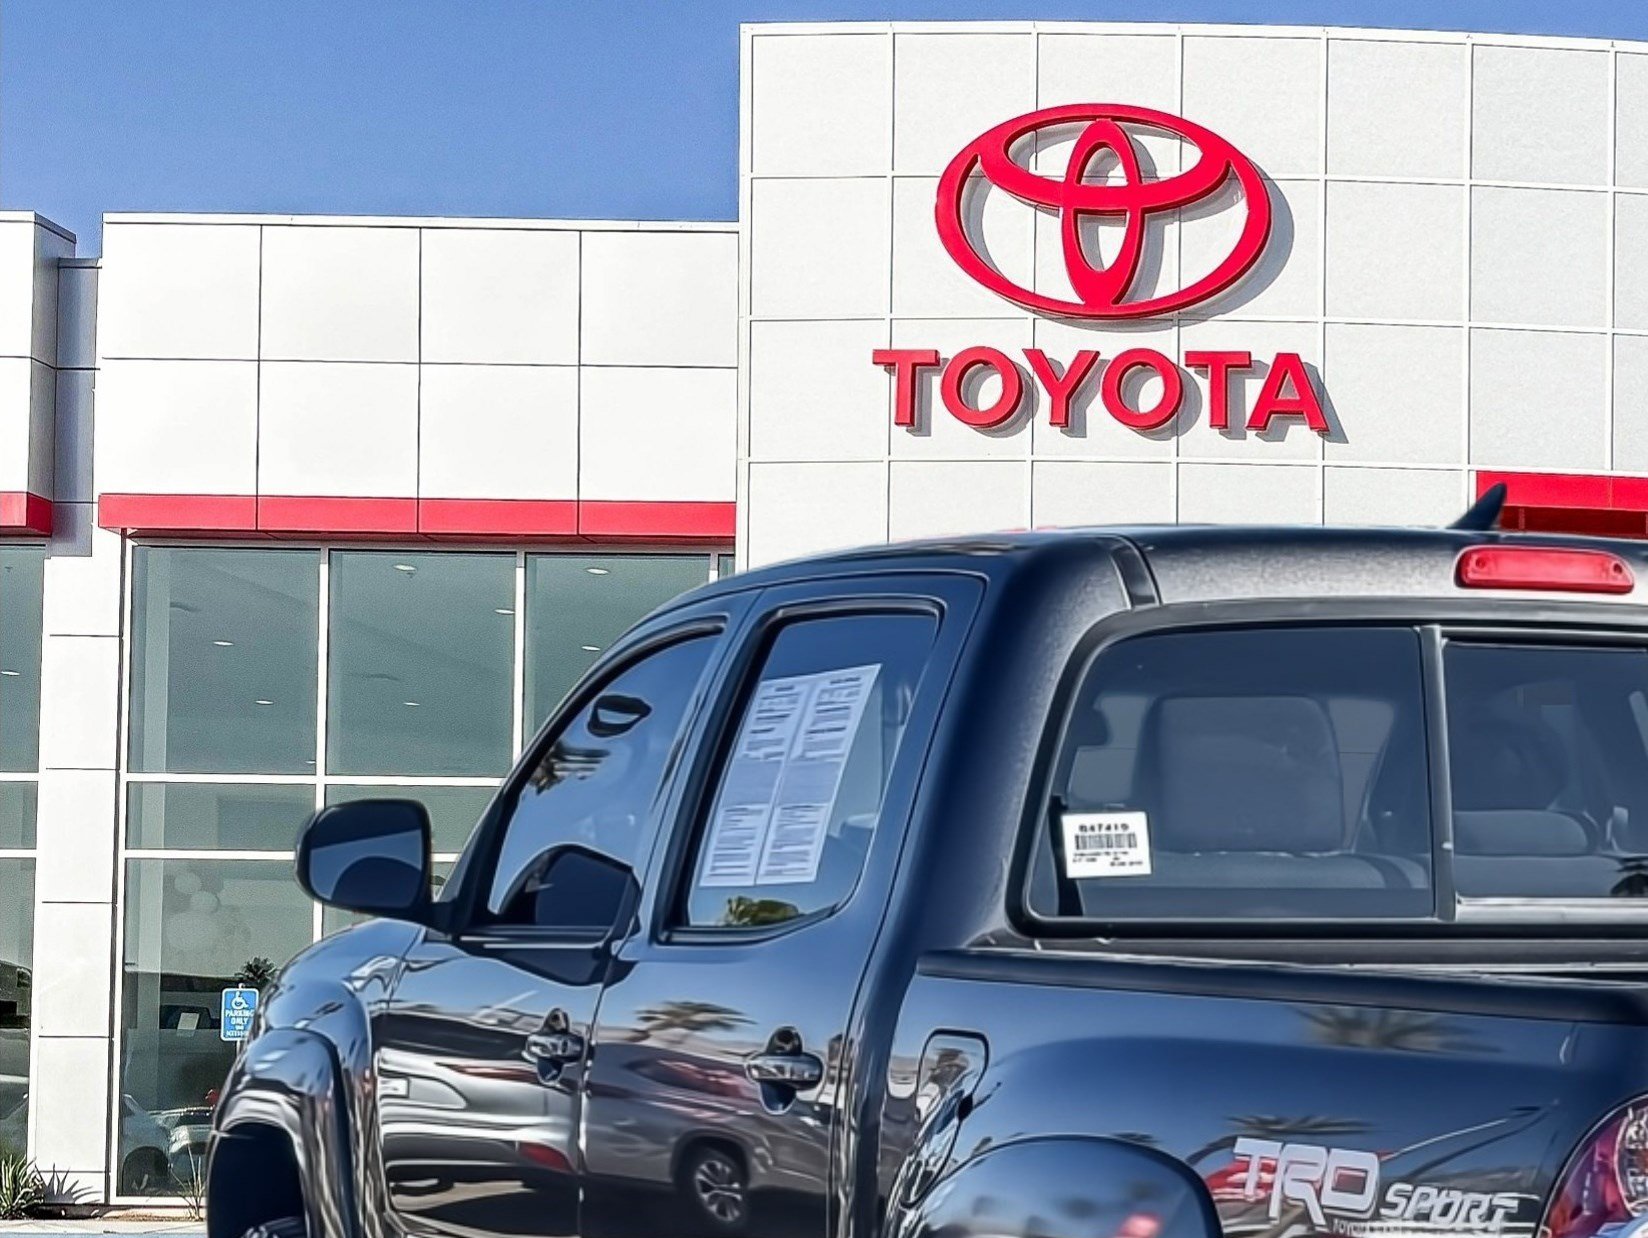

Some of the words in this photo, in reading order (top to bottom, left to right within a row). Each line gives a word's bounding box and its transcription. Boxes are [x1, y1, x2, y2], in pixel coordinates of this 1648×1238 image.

[873, 345, 1329, 432] TOYOTA
[1233, 1137, 1380, 1232] TRD
[1379, 1182, 1519, 1232] SPORT
